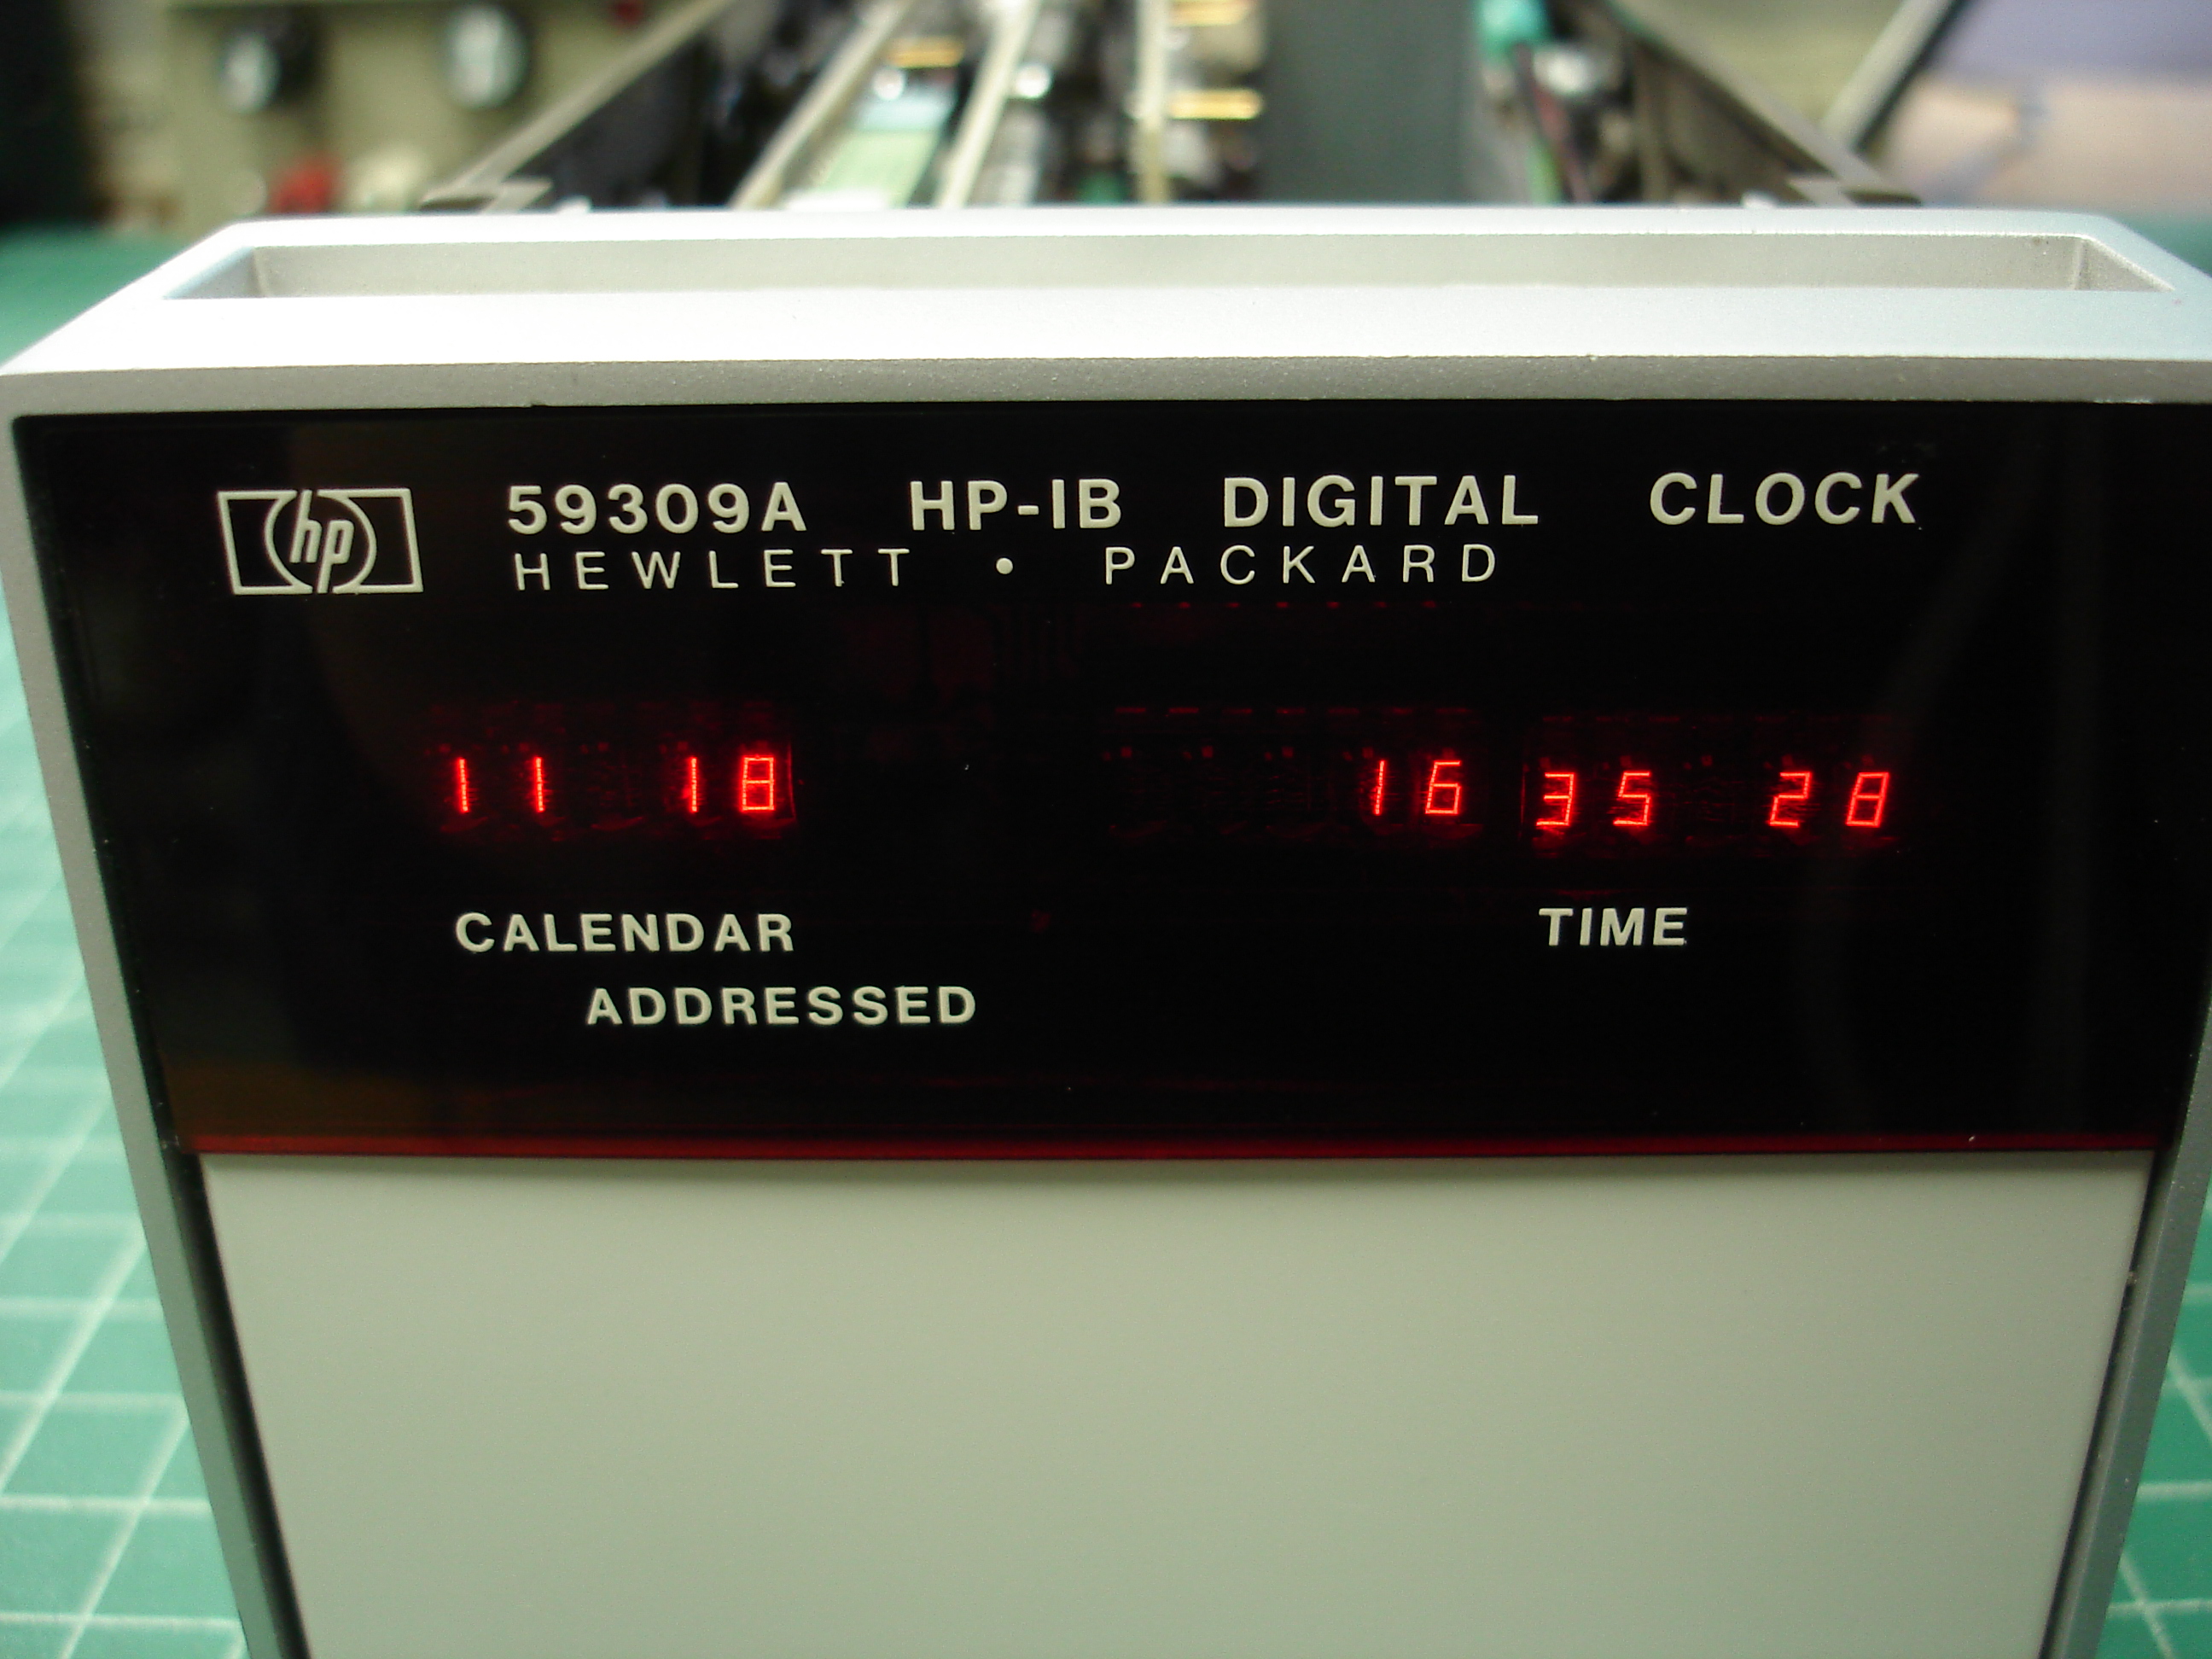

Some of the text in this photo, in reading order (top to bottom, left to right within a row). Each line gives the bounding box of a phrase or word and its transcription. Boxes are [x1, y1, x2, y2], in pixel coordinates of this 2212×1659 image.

[507, 470, 1921, 535] 59309A HP-IB DIGITAL CLOCK
[514, 544, 1497, 591] HEWLETT PACKARD
[681, 752, 778, 816] 18
[1369, 759, 1892, 835] 16 35 28
[454, 911, 795, 953] CALENDAR
[1538, 906, 1689, 946] TIME
[586, 985, 976, 1026] ADDRESSED
